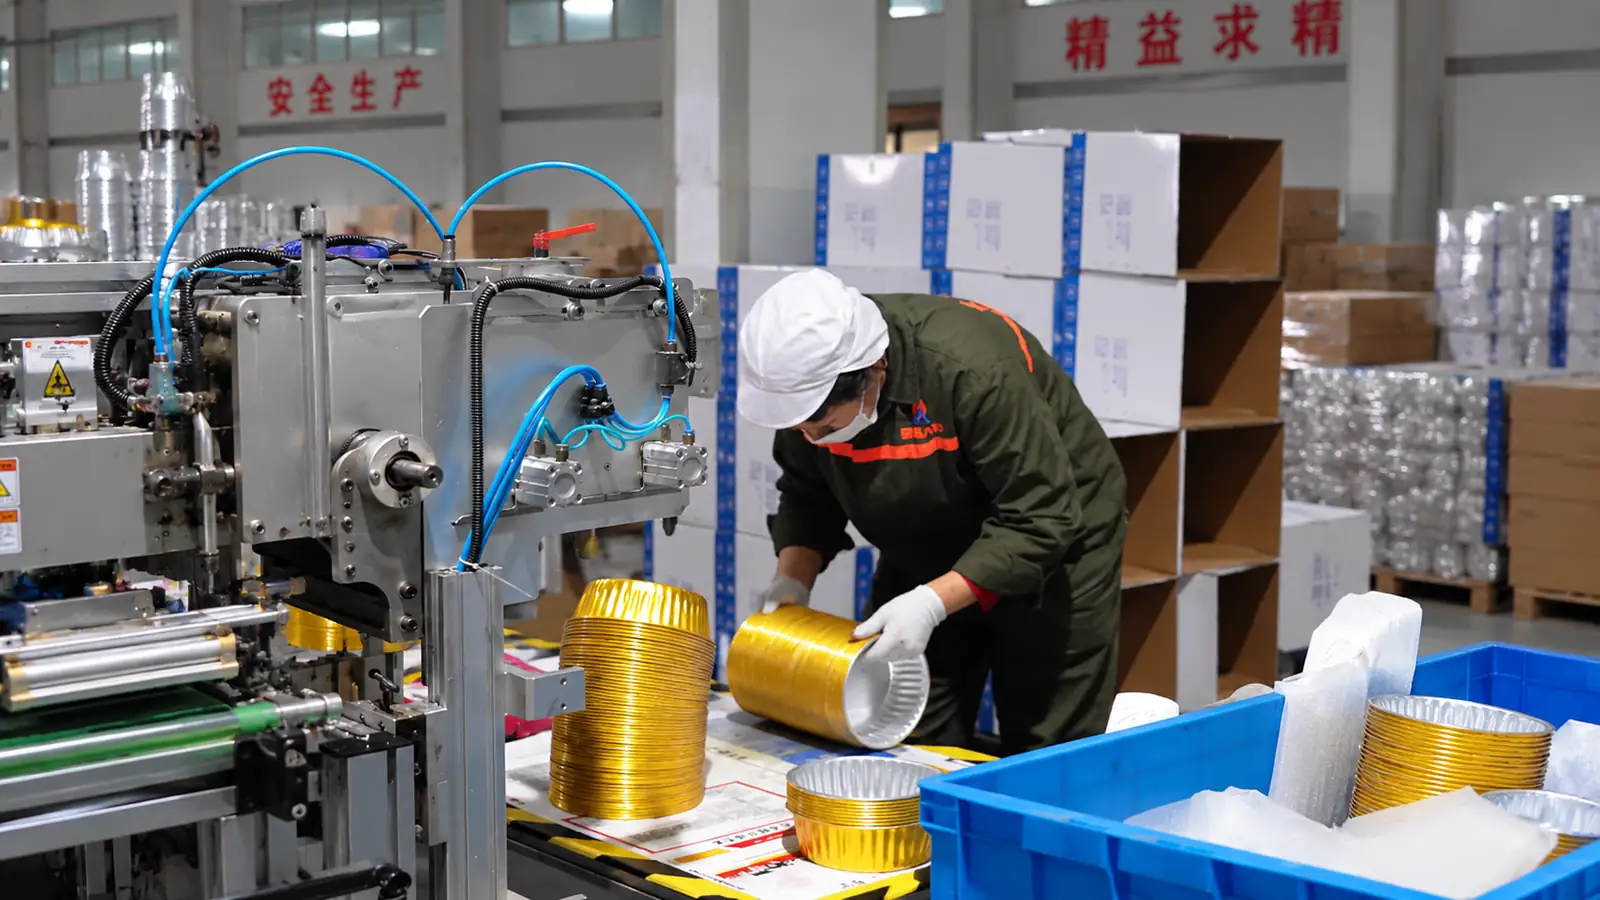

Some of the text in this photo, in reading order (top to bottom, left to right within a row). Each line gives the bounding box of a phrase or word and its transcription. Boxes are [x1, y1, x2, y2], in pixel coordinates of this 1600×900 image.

[1065, 0, 1342, 71] 精益求精
[267, 65, 422, 116] 安全生产
